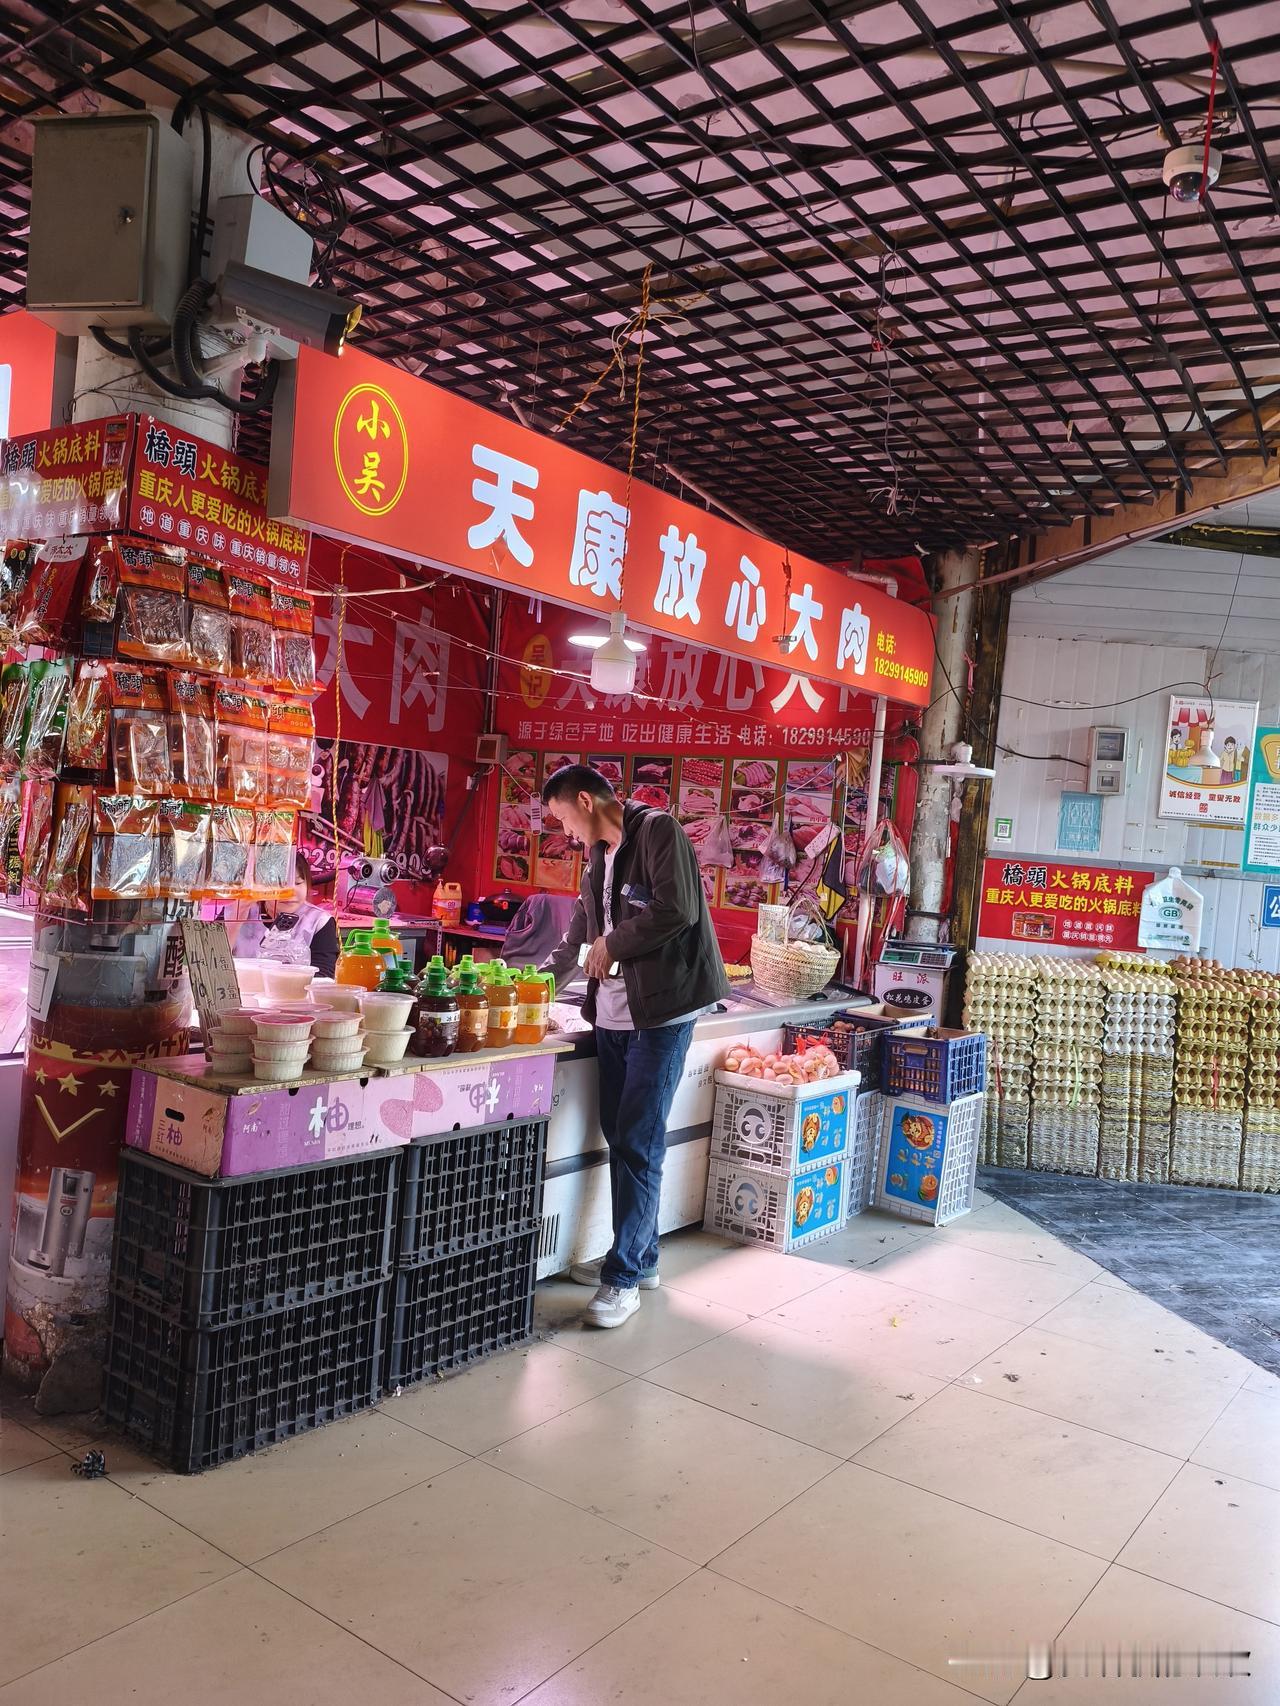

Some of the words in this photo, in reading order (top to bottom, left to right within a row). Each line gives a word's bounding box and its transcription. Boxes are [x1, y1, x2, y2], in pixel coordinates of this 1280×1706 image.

[37, 430, 101, 468] 火锅底料
[144, 426, 197, 480] 橋頭
[354, 399, 391, 504] 小吴
[138, 469, 307, 557] 重庆人更爱吃的火锅底料
[140, 505, 226, 552] 地道重庆味
[230, 537, 301, 578] 重庆销量领先
[874, 656, 929, 688] 18299145909
[518, 720, 615, 743] 源于绿色产地
[622, 722, 732, 746] 吃出健康生活
[1002, 863, 1048, 889] 橋頭
[1050, 869, 1135, 897] 火锅底料
[1163, 909, 1179, 918] GB
[166, 1123, 183, 1146] 柚
[308, 1096, 350, 1138] 柚
